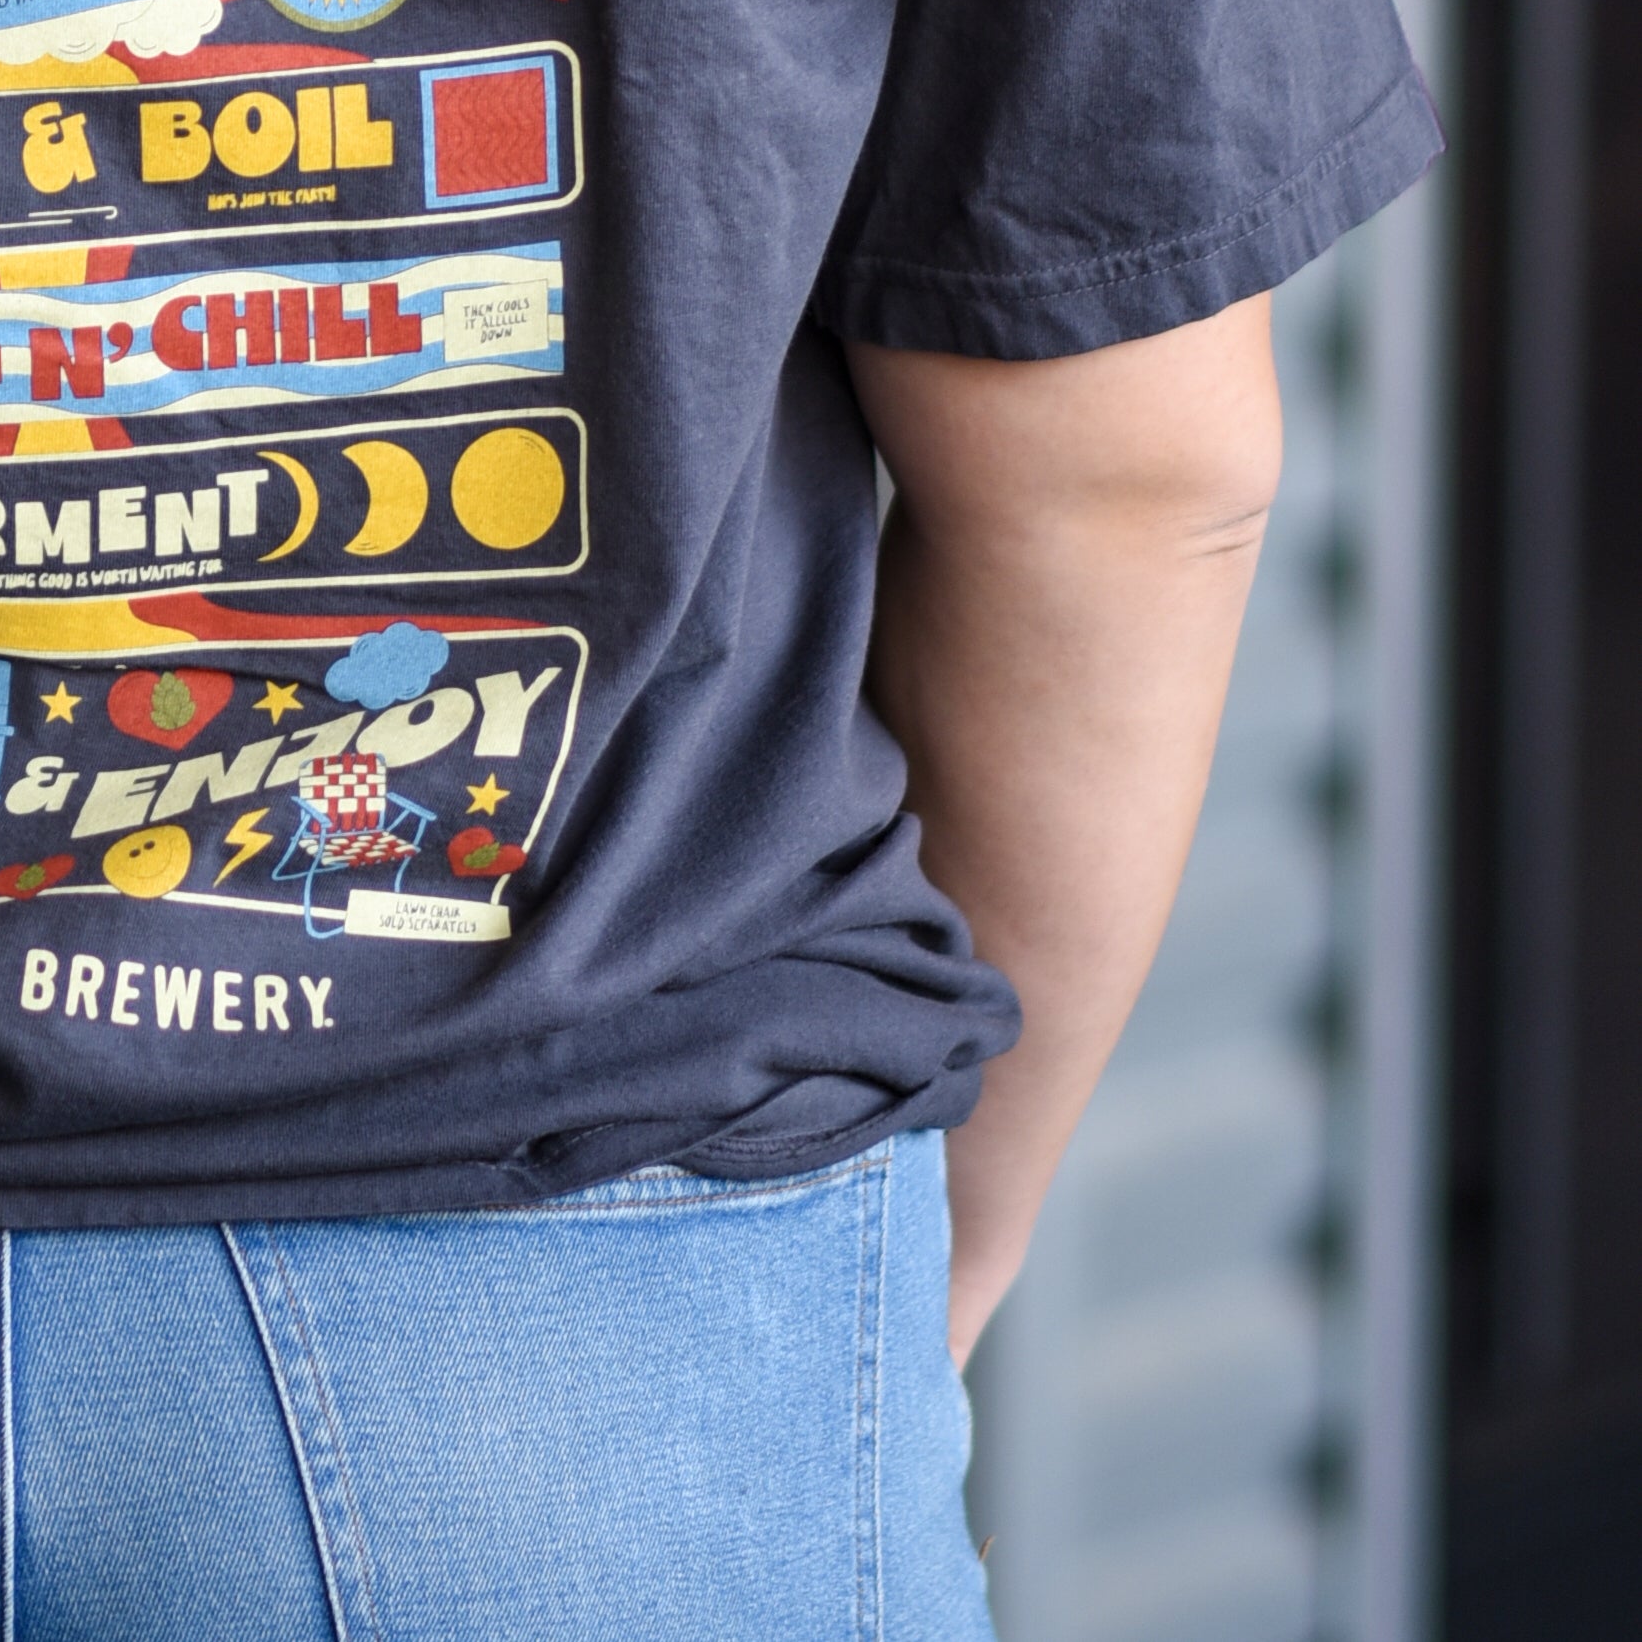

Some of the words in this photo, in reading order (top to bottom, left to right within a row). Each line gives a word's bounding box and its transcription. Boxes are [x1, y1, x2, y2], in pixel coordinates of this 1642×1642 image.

[23, 101, 96, 193] &
[140, 84, 393, 183] BOIL
[267, 190, 294, 206] THE
[463, 302, 493, 318] THEN
[497, 297, 529, 313] COOLS
[465, 318, 476, 330] IT
[29, 322, 133, 400] N'
[152, 283, 421, 371] CHILL
[481, 327, 512, 344] DOWN
[39, 572, 72, 589] GOOD
[76, 571, 87, 587] IS
[91, 568, 137, 587] WORTH
[139, 561, 196, 581] WAITING
[198, 558, 223, 577] FOR
[5, 756, 79, 815] &
[71, 667, 562, 838] ENJOY
[395, 901, 427, 915] LAWN
[430, 904, 461, 918] CHAIR
[379, 914, 404, 930] SOLD
[409, 917, 477, 933] SEPARATELY
